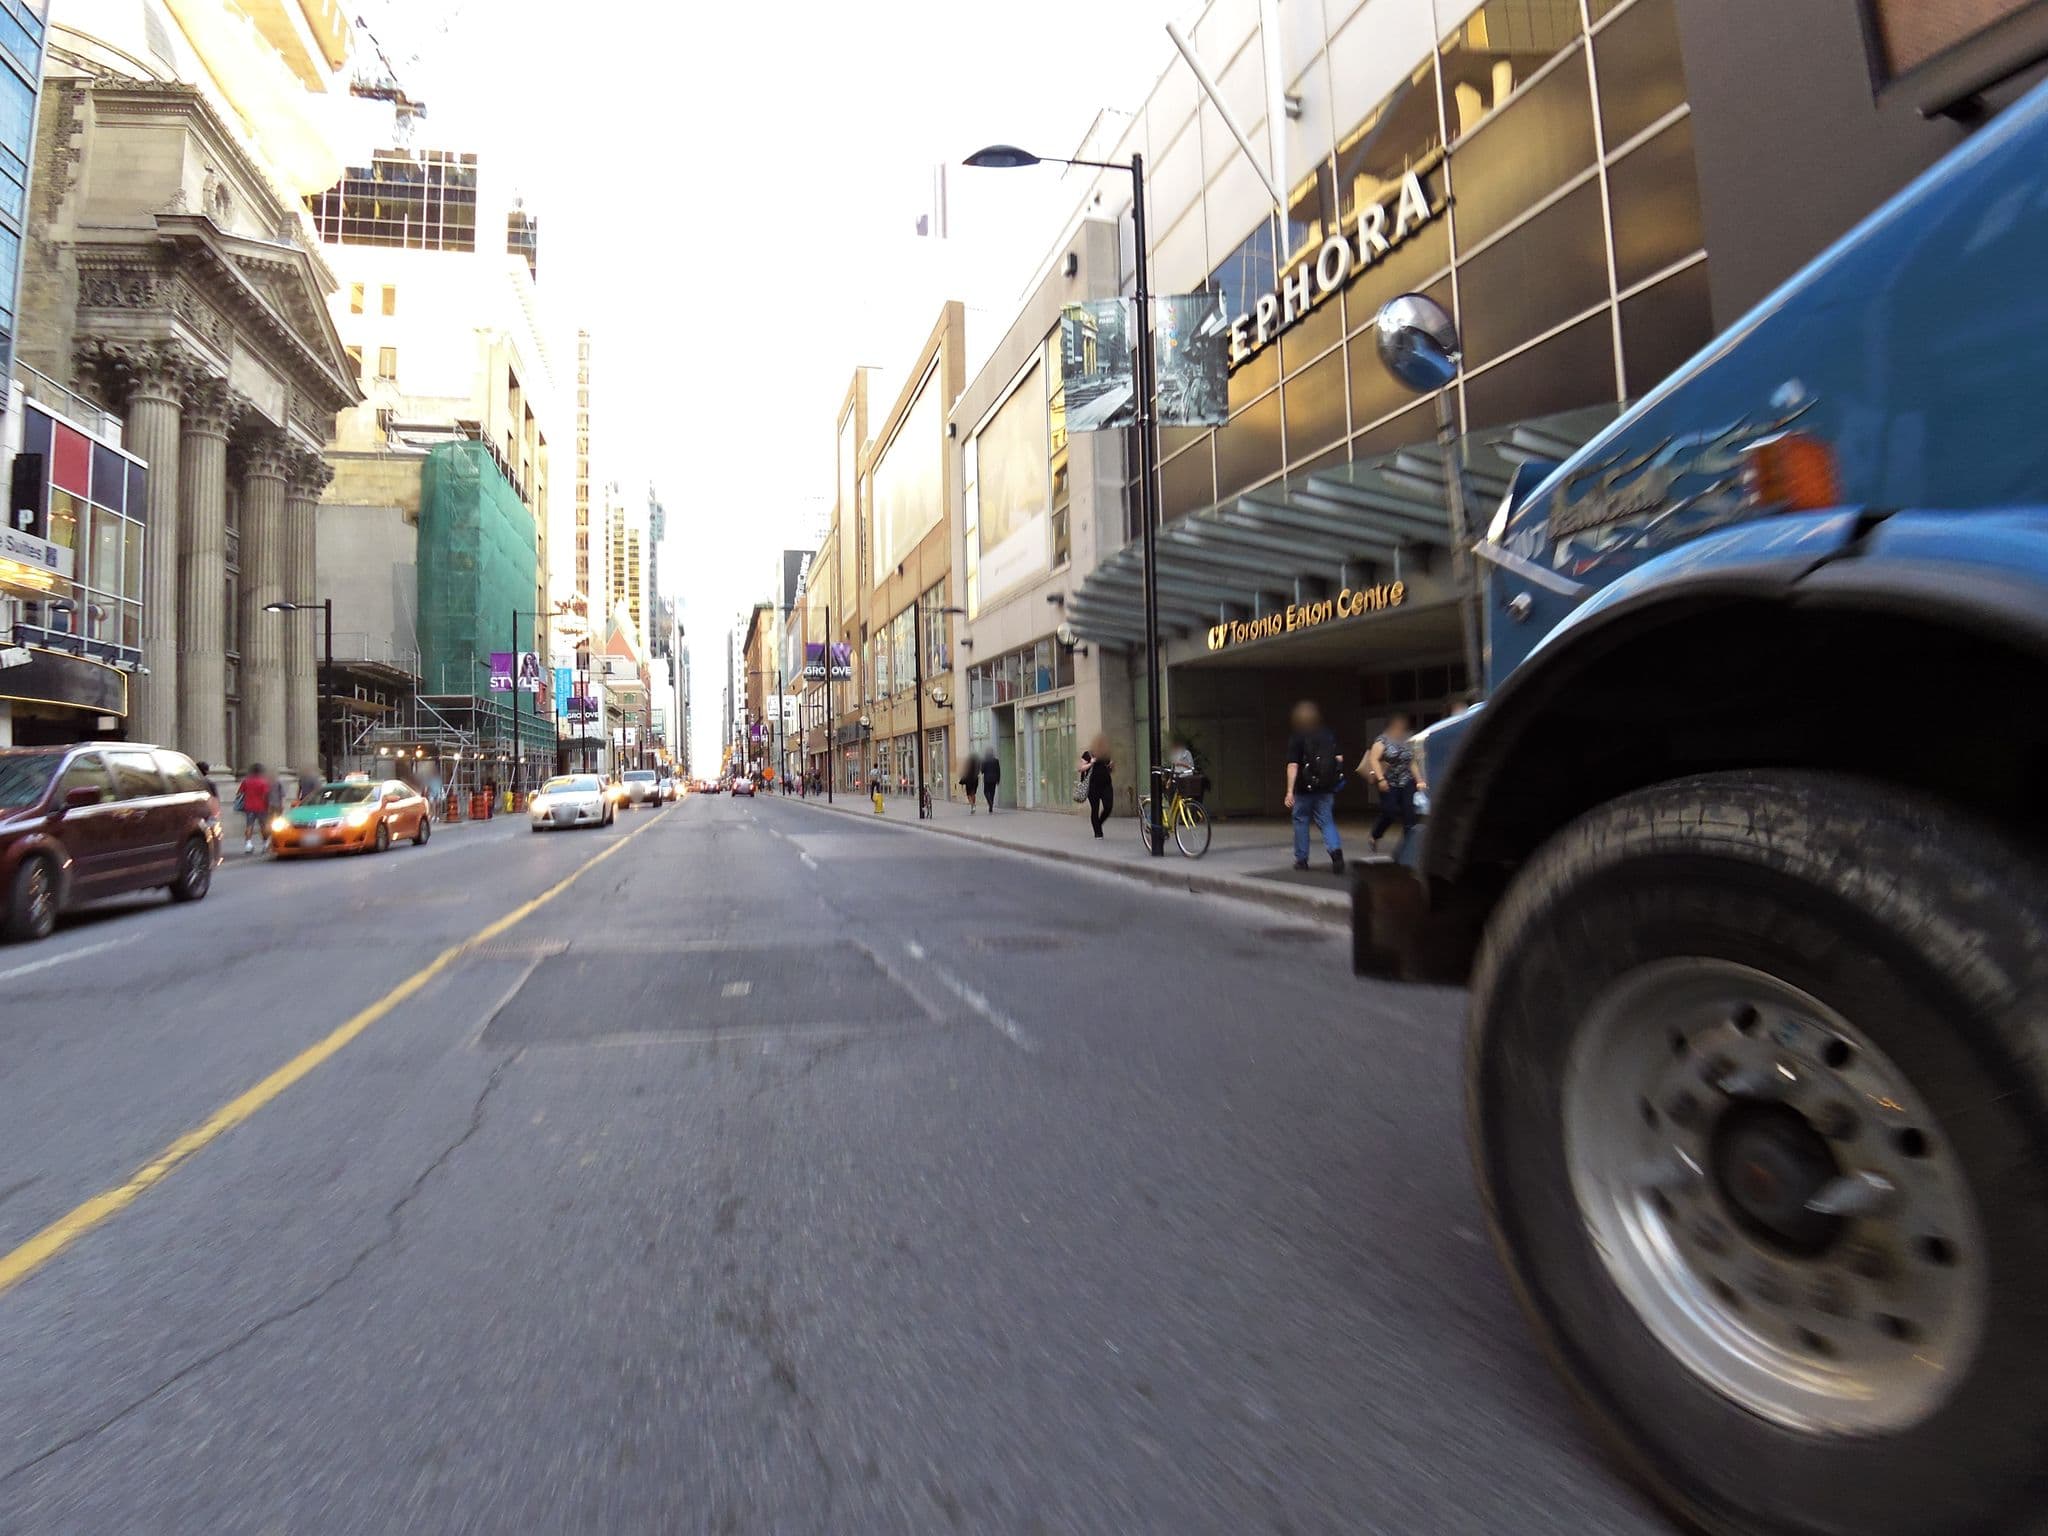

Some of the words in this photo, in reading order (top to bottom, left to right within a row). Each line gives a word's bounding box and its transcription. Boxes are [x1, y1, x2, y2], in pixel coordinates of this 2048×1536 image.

[1230, 169, 1431, 364] EPHORA
[1230, 613, 1282, 645] Toronto
[1286, 599, 1333, 632] Eaton
[1337, 580, 1405, 618] Centre
[489, 676, 540, 688] STYLE
